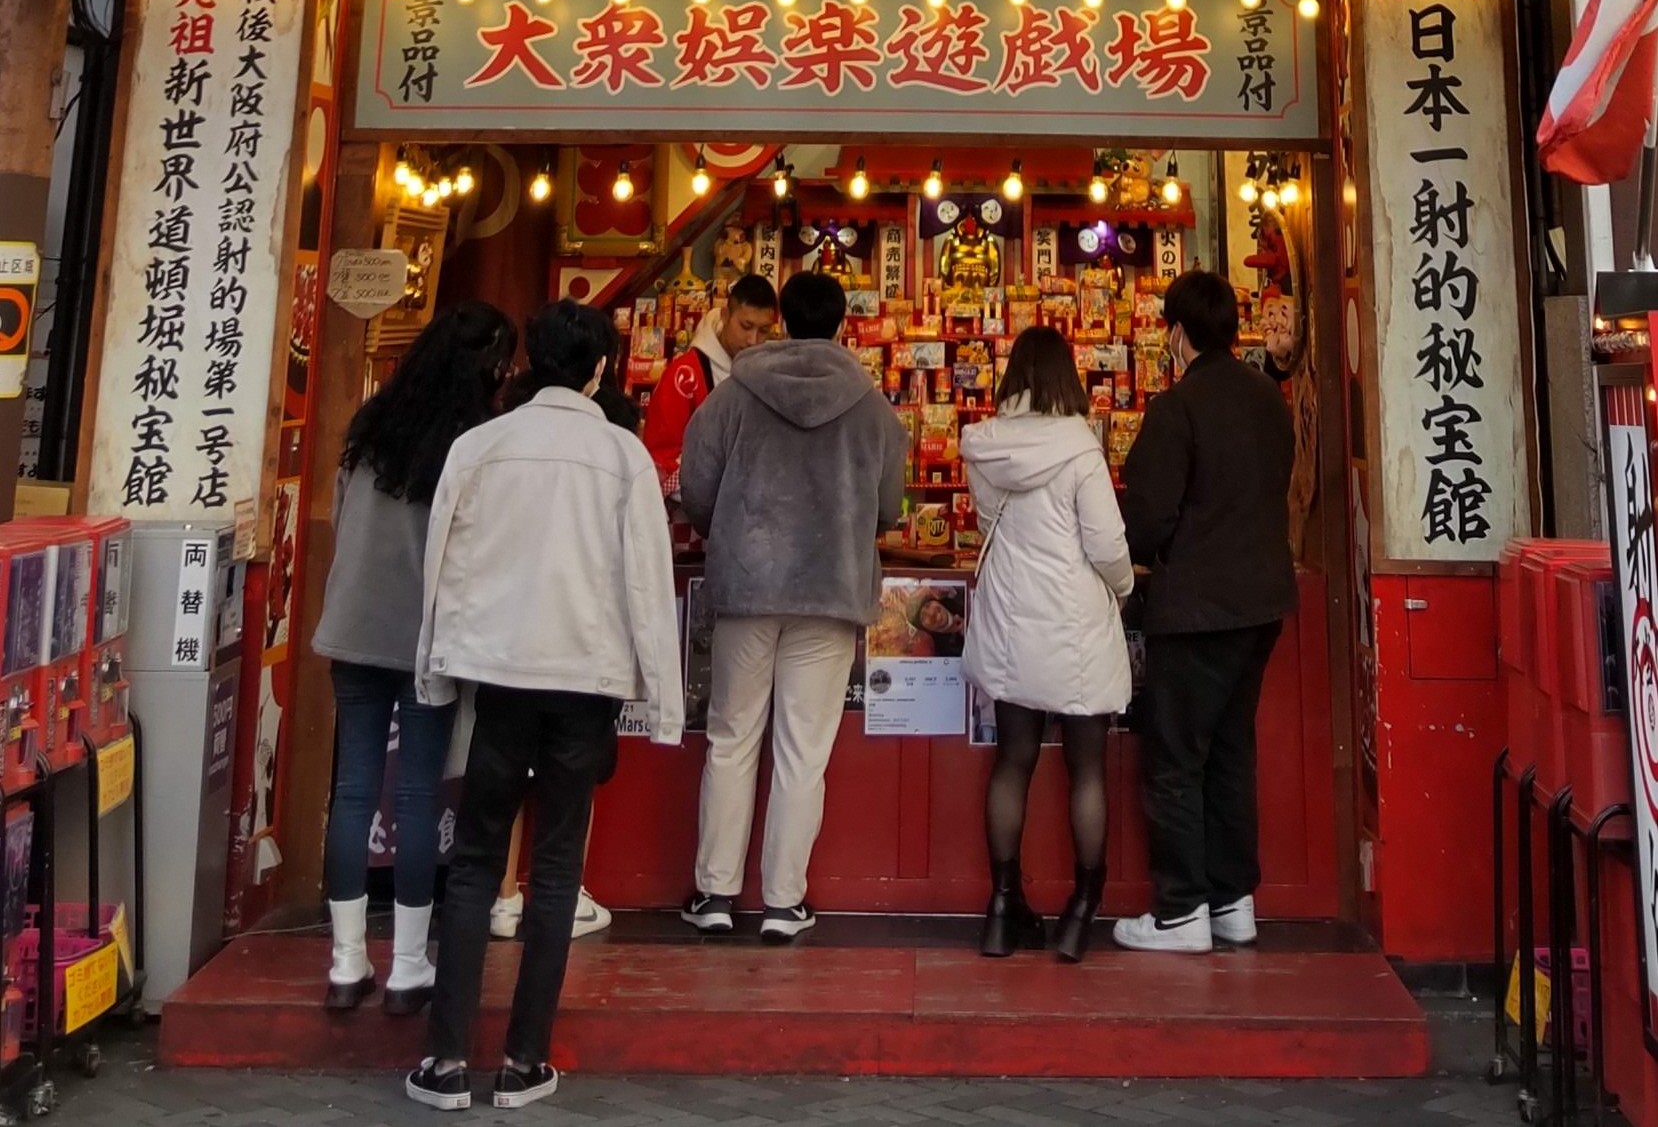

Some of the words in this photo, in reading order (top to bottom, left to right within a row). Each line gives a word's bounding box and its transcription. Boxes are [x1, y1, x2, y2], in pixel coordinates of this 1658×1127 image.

[464, 0, 1211, 102] 大衆娯楽遊戯場
[1403, 3, 1493, 546] 日本一射的秘宝館
[175, 542, 208, 663] 両替機
